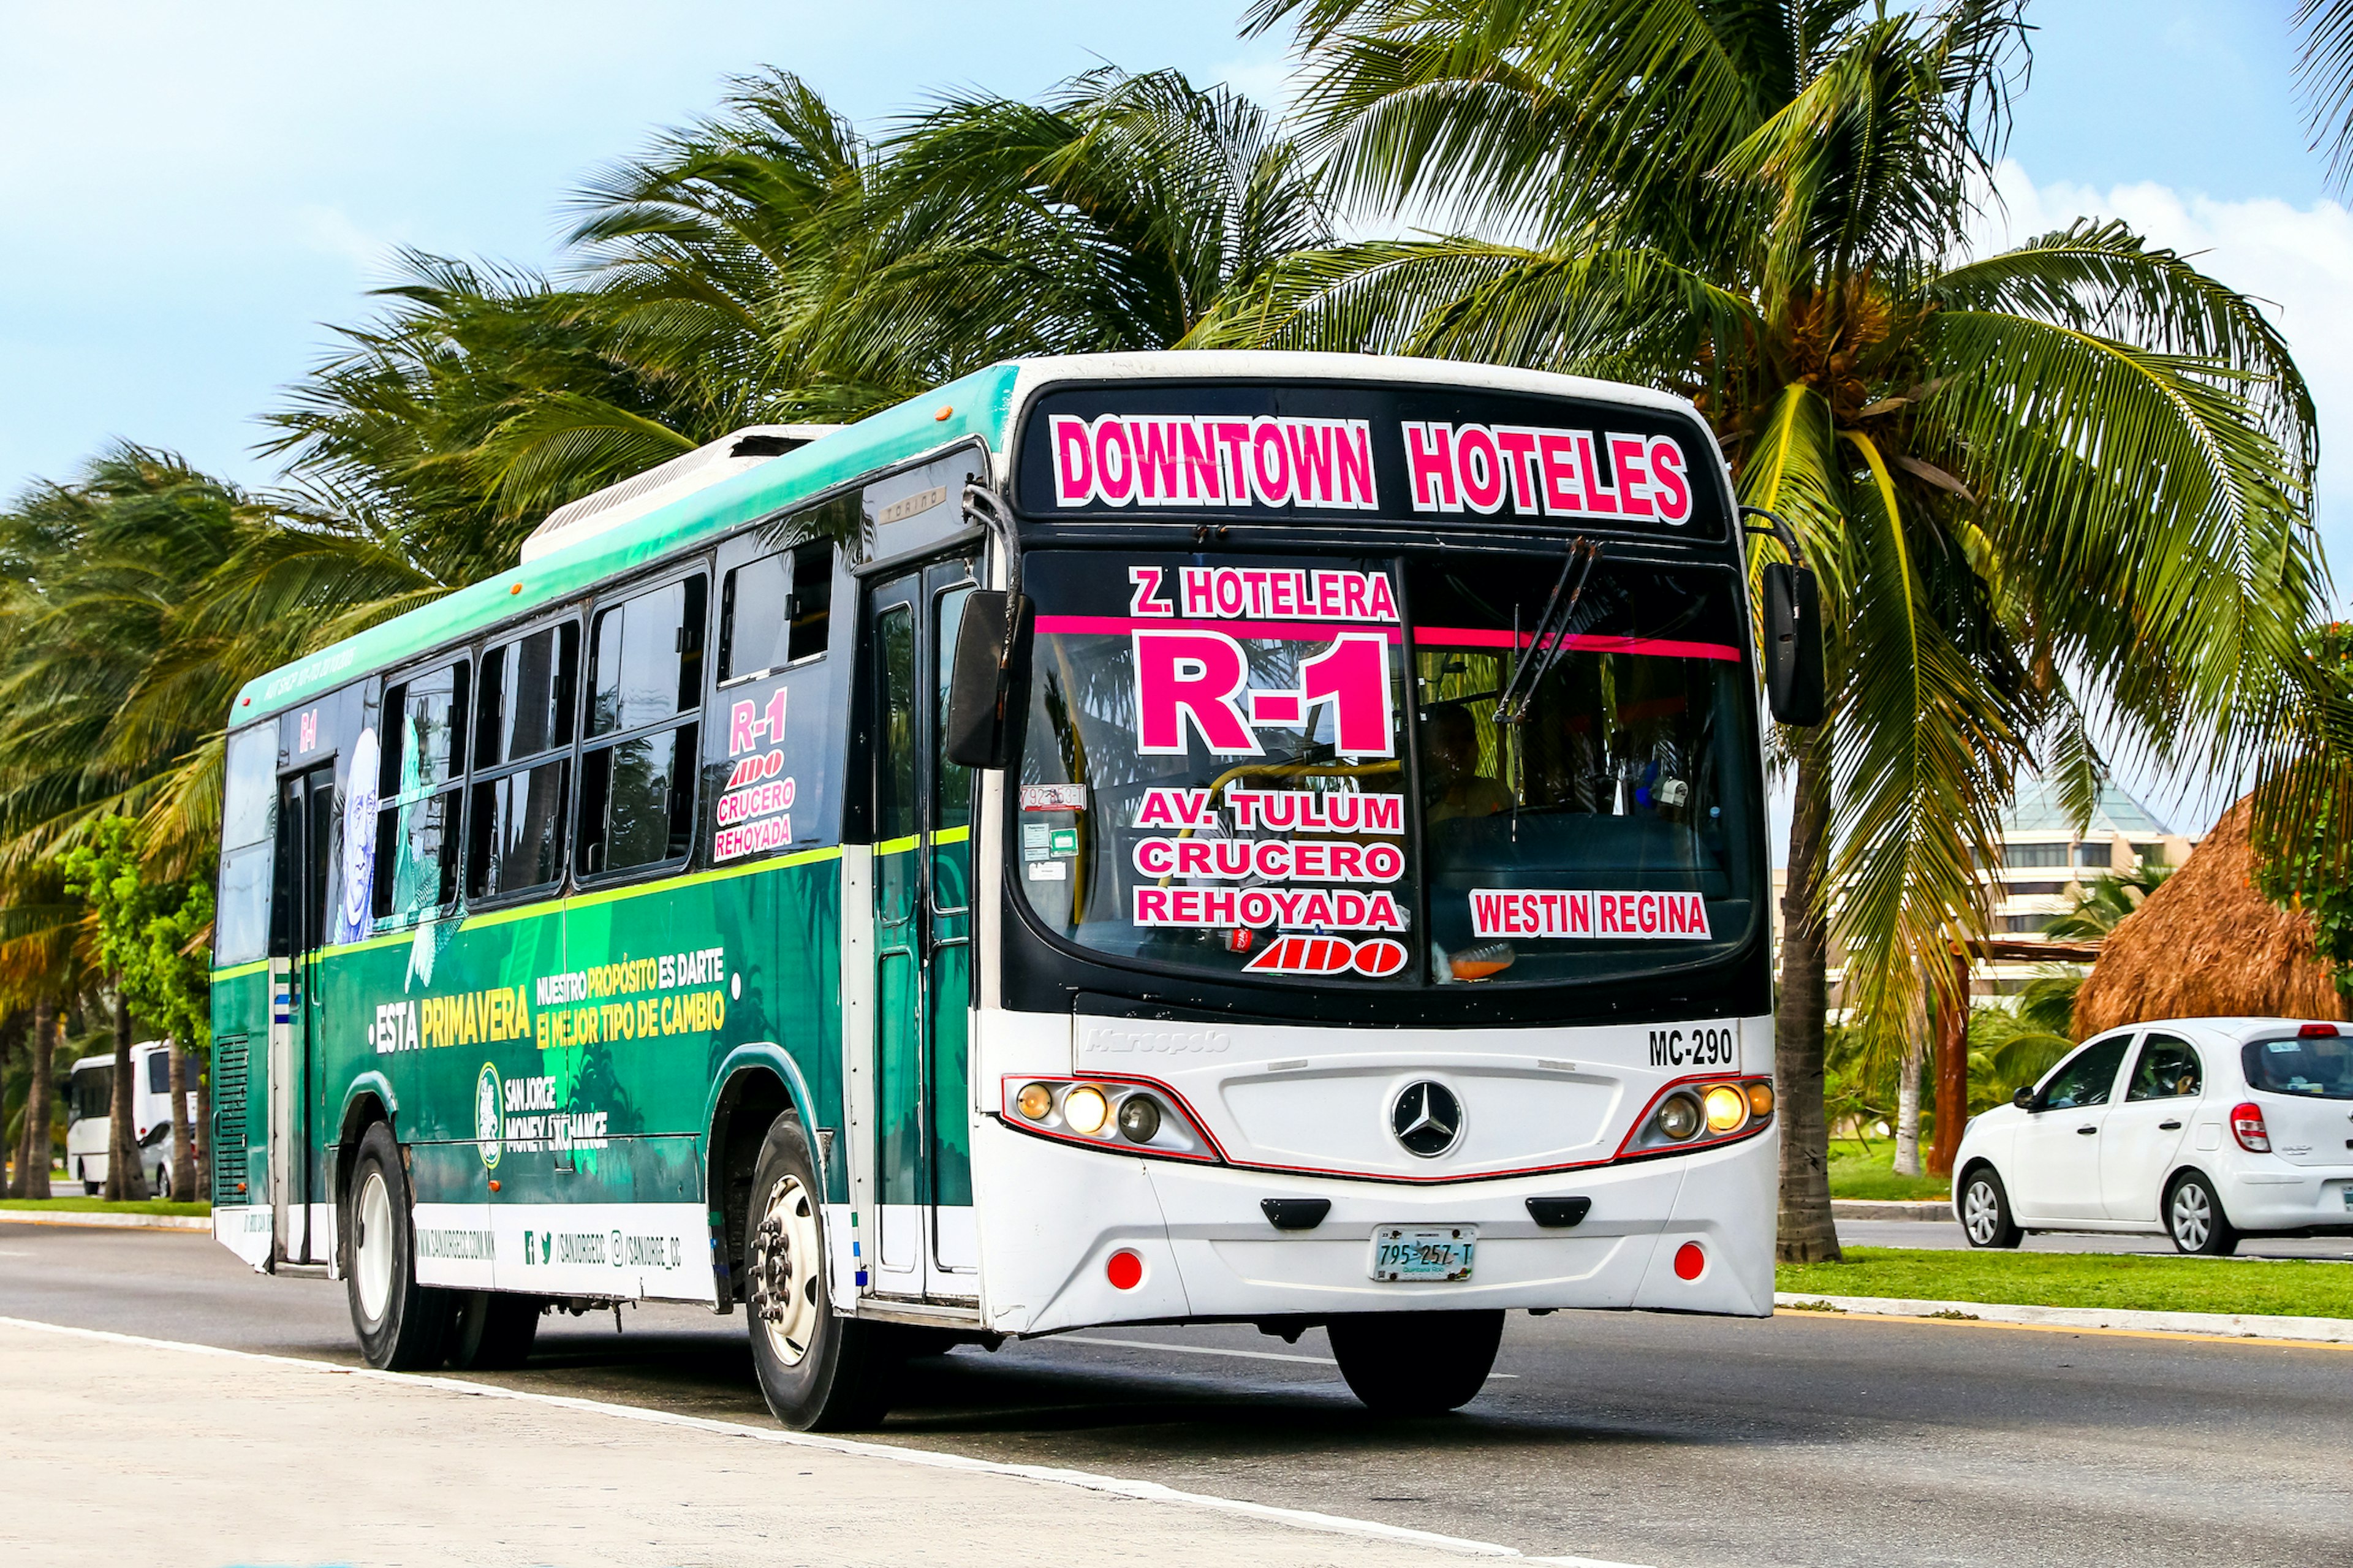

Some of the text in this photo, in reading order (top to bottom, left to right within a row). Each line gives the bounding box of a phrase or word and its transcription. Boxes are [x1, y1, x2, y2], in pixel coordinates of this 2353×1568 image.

[1051, 417, 1690, 523] DOWNTOWN HOTELES
[1132, 568, 1398, 620] Z. HOTELERA
[1135, 632, 1391, 754] R-1
[300, 709, 317, 753] R-1
[730, 689, 786, 755] R-1
[718, 779, 794, 824] CRUCERO
[1137, 790, 1402, 831] AV. TULUM
[715, 816, 790, 860] REHOYADA
[1135, 839, 1403, 881] CRUCERO
[1135, 887, 1402, 929] REHOYADA
[1474, 893, 1707, 934] WESTIN REGINA
[536, 947, 724, 1006] NUESTRO PROPÓSITO ES DARTE
[376, 985, 531, 1054] ESTA PRIMAVERA
[551, 1007, 599, 1048] MEJOR
[600, 1001, 635, 1042] TIPO
[637, 998, 659, 1039] DE
[660, 990, 726, 1037] CAMBIO
[1085, 1029, 1231, 1055] Marcopolo
[1648, 1028, 1733, 1067] MC-290
[504, 1075, 556, 1113] SAN JORGE
[505, 1111, 608, 1153] MONEY EXCHANGE
